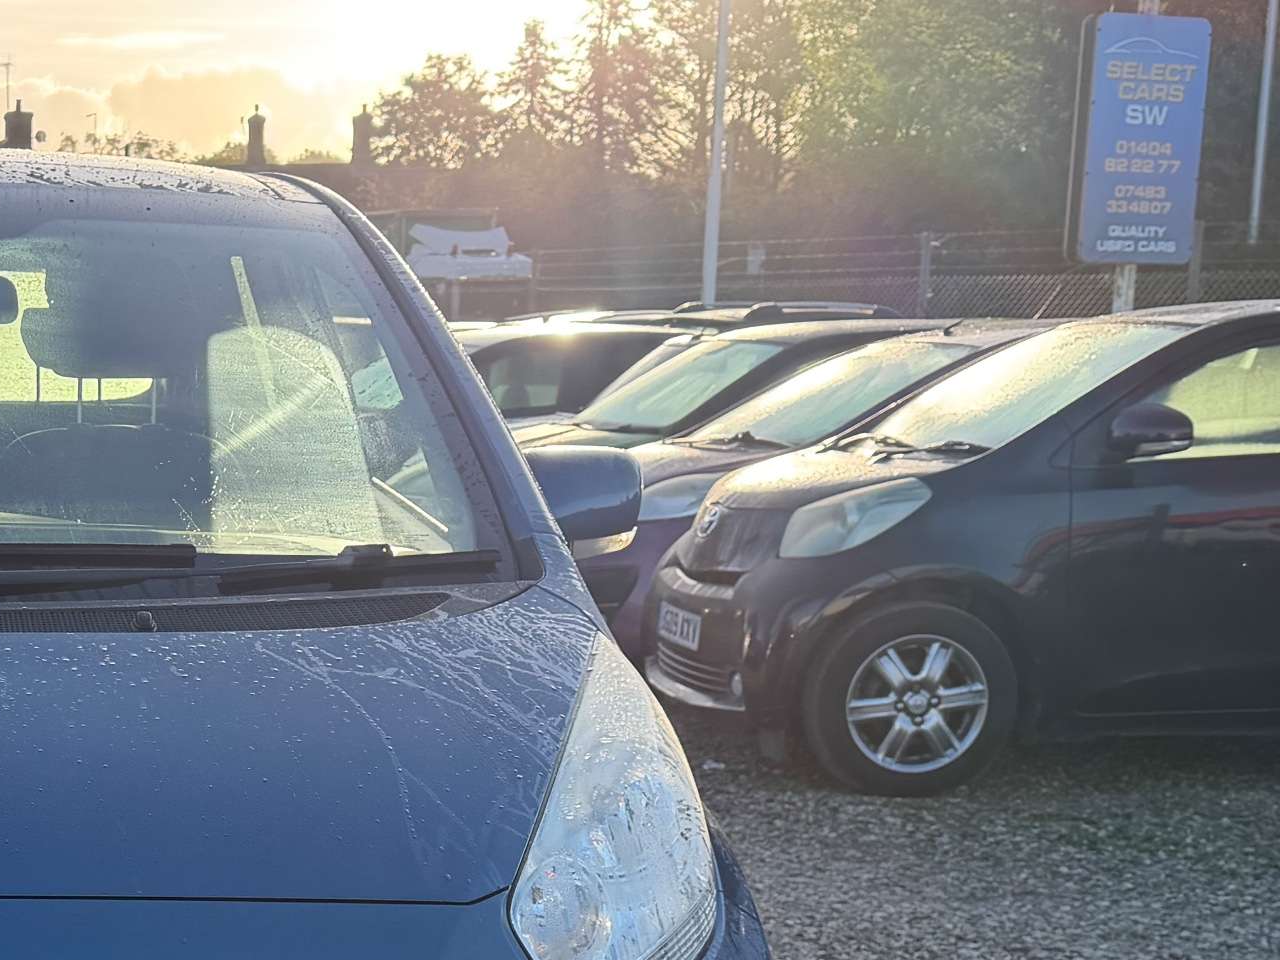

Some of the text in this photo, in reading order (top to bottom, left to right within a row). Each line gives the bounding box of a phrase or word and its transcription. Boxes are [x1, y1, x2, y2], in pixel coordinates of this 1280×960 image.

[1106, 60, 1197, 82] SELECT
[1119, 81, 1185, 102] CARS
[1125, 104, 1168, 126] SW
[1116, 140, 1172, 155] 01404
[1108, 225, 1167, 238] QUALITY
[1138, 240, 1176, 253] CARS
